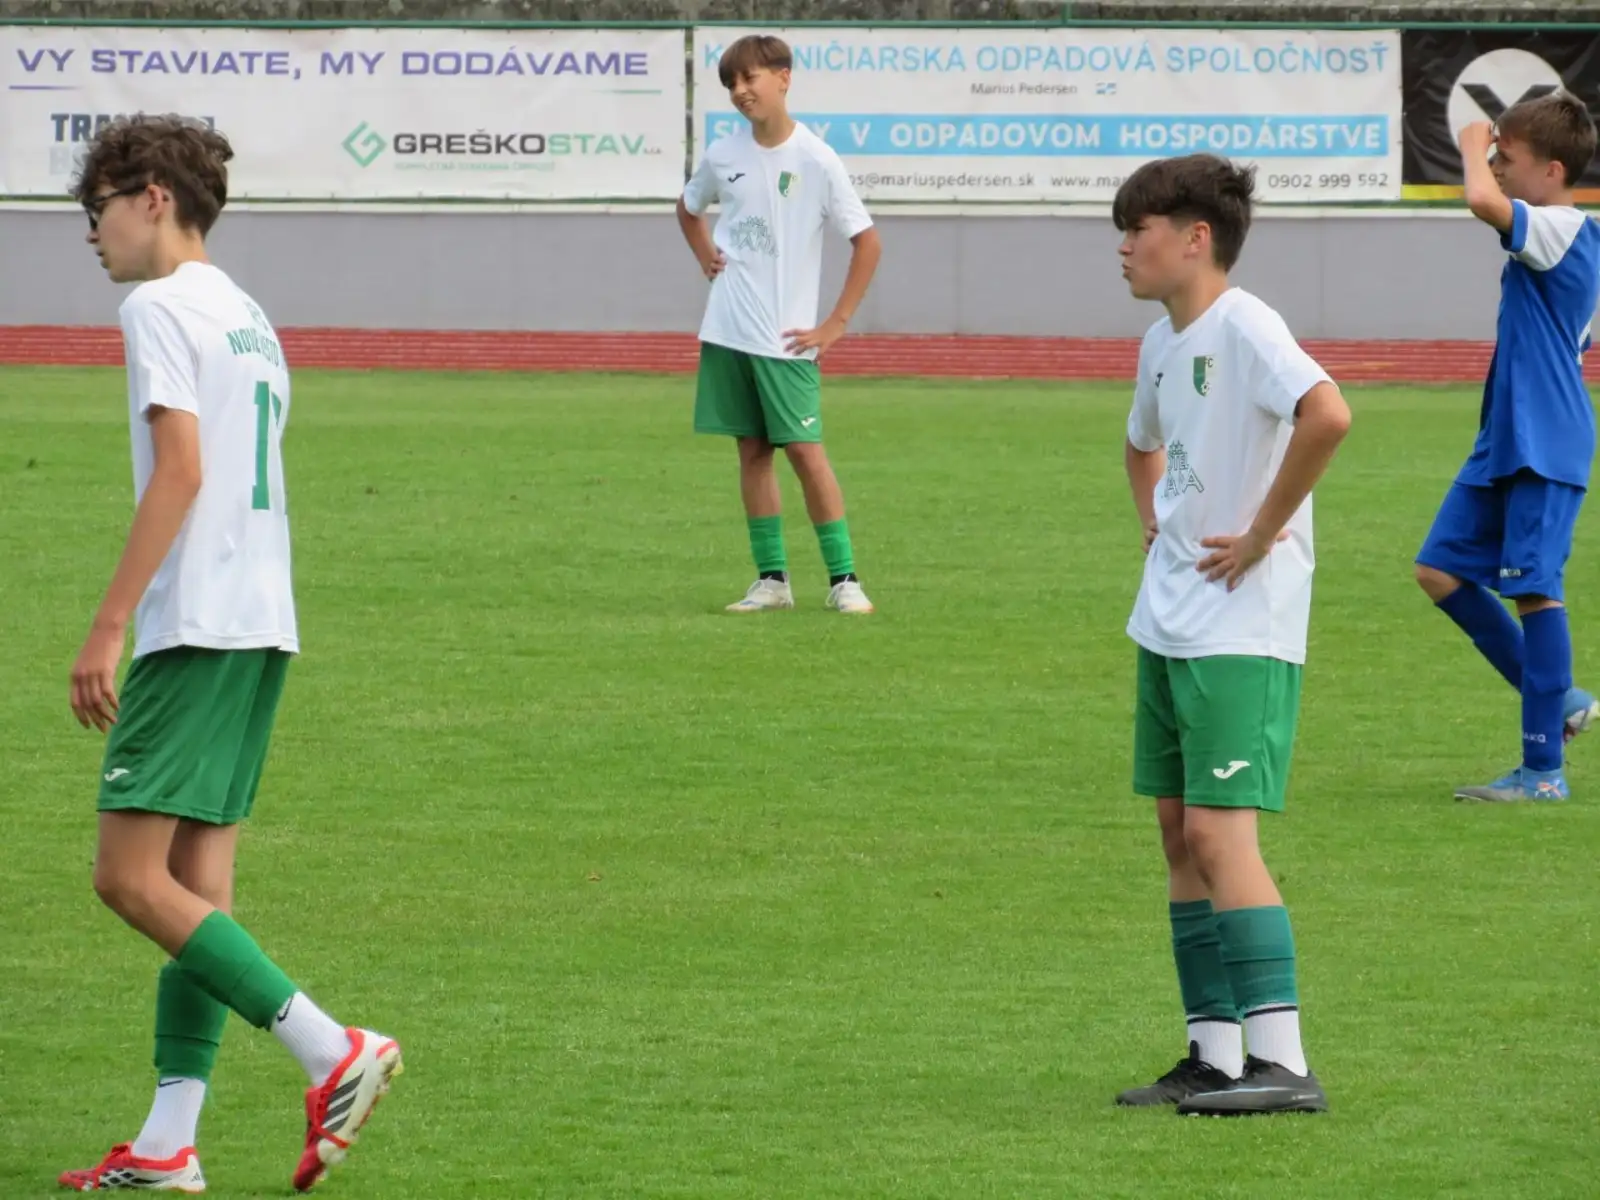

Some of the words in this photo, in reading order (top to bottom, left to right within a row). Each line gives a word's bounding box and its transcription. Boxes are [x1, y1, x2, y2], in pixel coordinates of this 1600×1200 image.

[17, 49, 75, 72] VY
[91, 50, 301, 79] STAVIATE,
[319, 51, 386, 75] MY
[401, 46, 649, 76] DODÁVAME
[705, 41, 966, 71] KNIČIARSKA
[976, 42, 1156, 72] ODPADOVÁ
[1166, 41, 1389, 74] SPOLOČNOSŤ
[970, 82, 1015, 95] Marius
[1018, 82, 1078, 95] Pedersen
[393, 128, 645, 155] GREŠKOSTAV
[851, 122, 871, 147] V
[890, 122, 1101, 148] ODPADOVOM
[1119, 118, 1381, 149] HOSPODÁRSTVE
[850, 173, 1035, 189] os@mariuspedersen.sk
[1267, 174, 1312, 188] 0902
[1318, 174, 1350, 188] 999
[1358, 173, 1388, 187] 592
